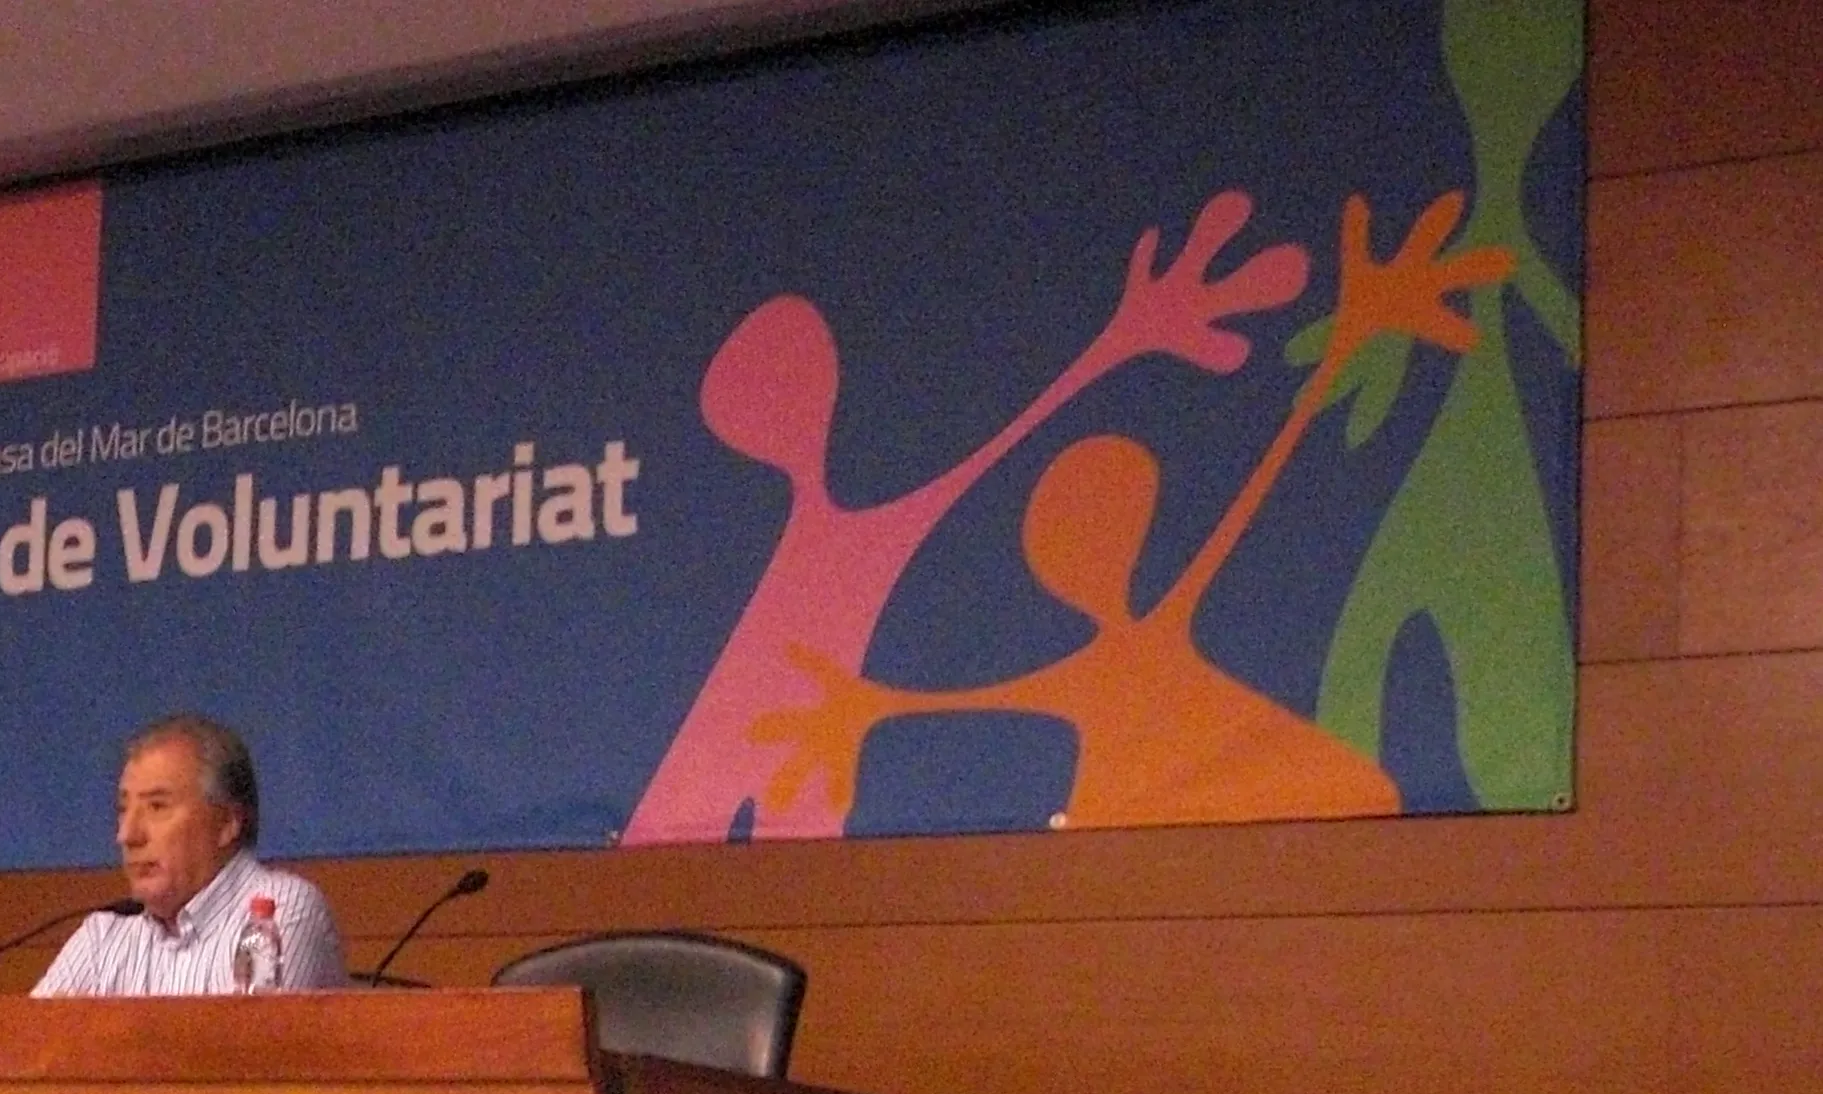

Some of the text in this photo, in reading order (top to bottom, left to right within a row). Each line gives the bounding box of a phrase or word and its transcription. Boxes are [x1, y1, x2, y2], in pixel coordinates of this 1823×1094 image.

[39, 431, 82, 467] del
[90, 423, 147, 462] Mar
[156, 417, 195, 453] de
[201, 401, 358, 449] Barcelona
[116, 440, 641, 582] Voluntariat
